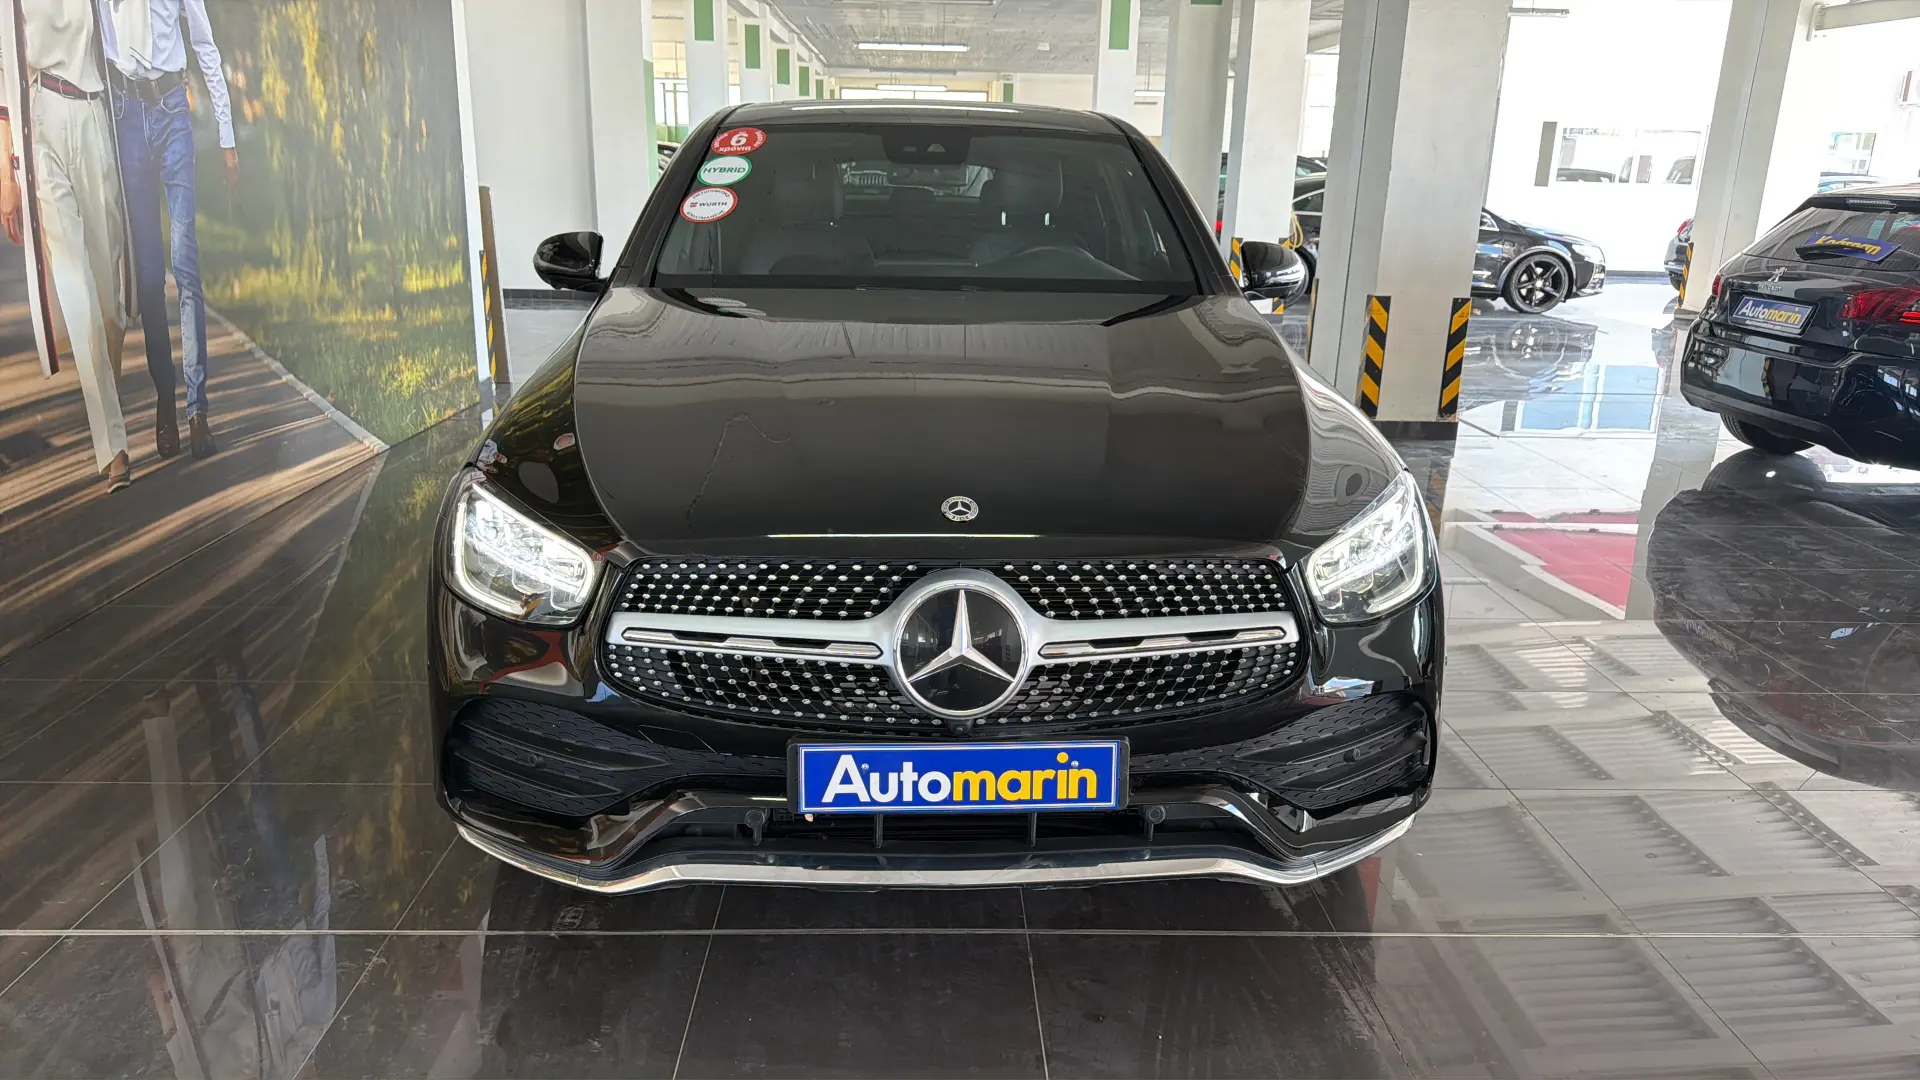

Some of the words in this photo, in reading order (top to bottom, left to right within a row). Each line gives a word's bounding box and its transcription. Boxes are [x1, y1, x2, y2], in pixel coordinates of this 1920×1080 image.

[730, 133, 748, 146] 6
[1738, 300, 1801, 324] Automarin
[821, 752, 1098, 803] Automarin
